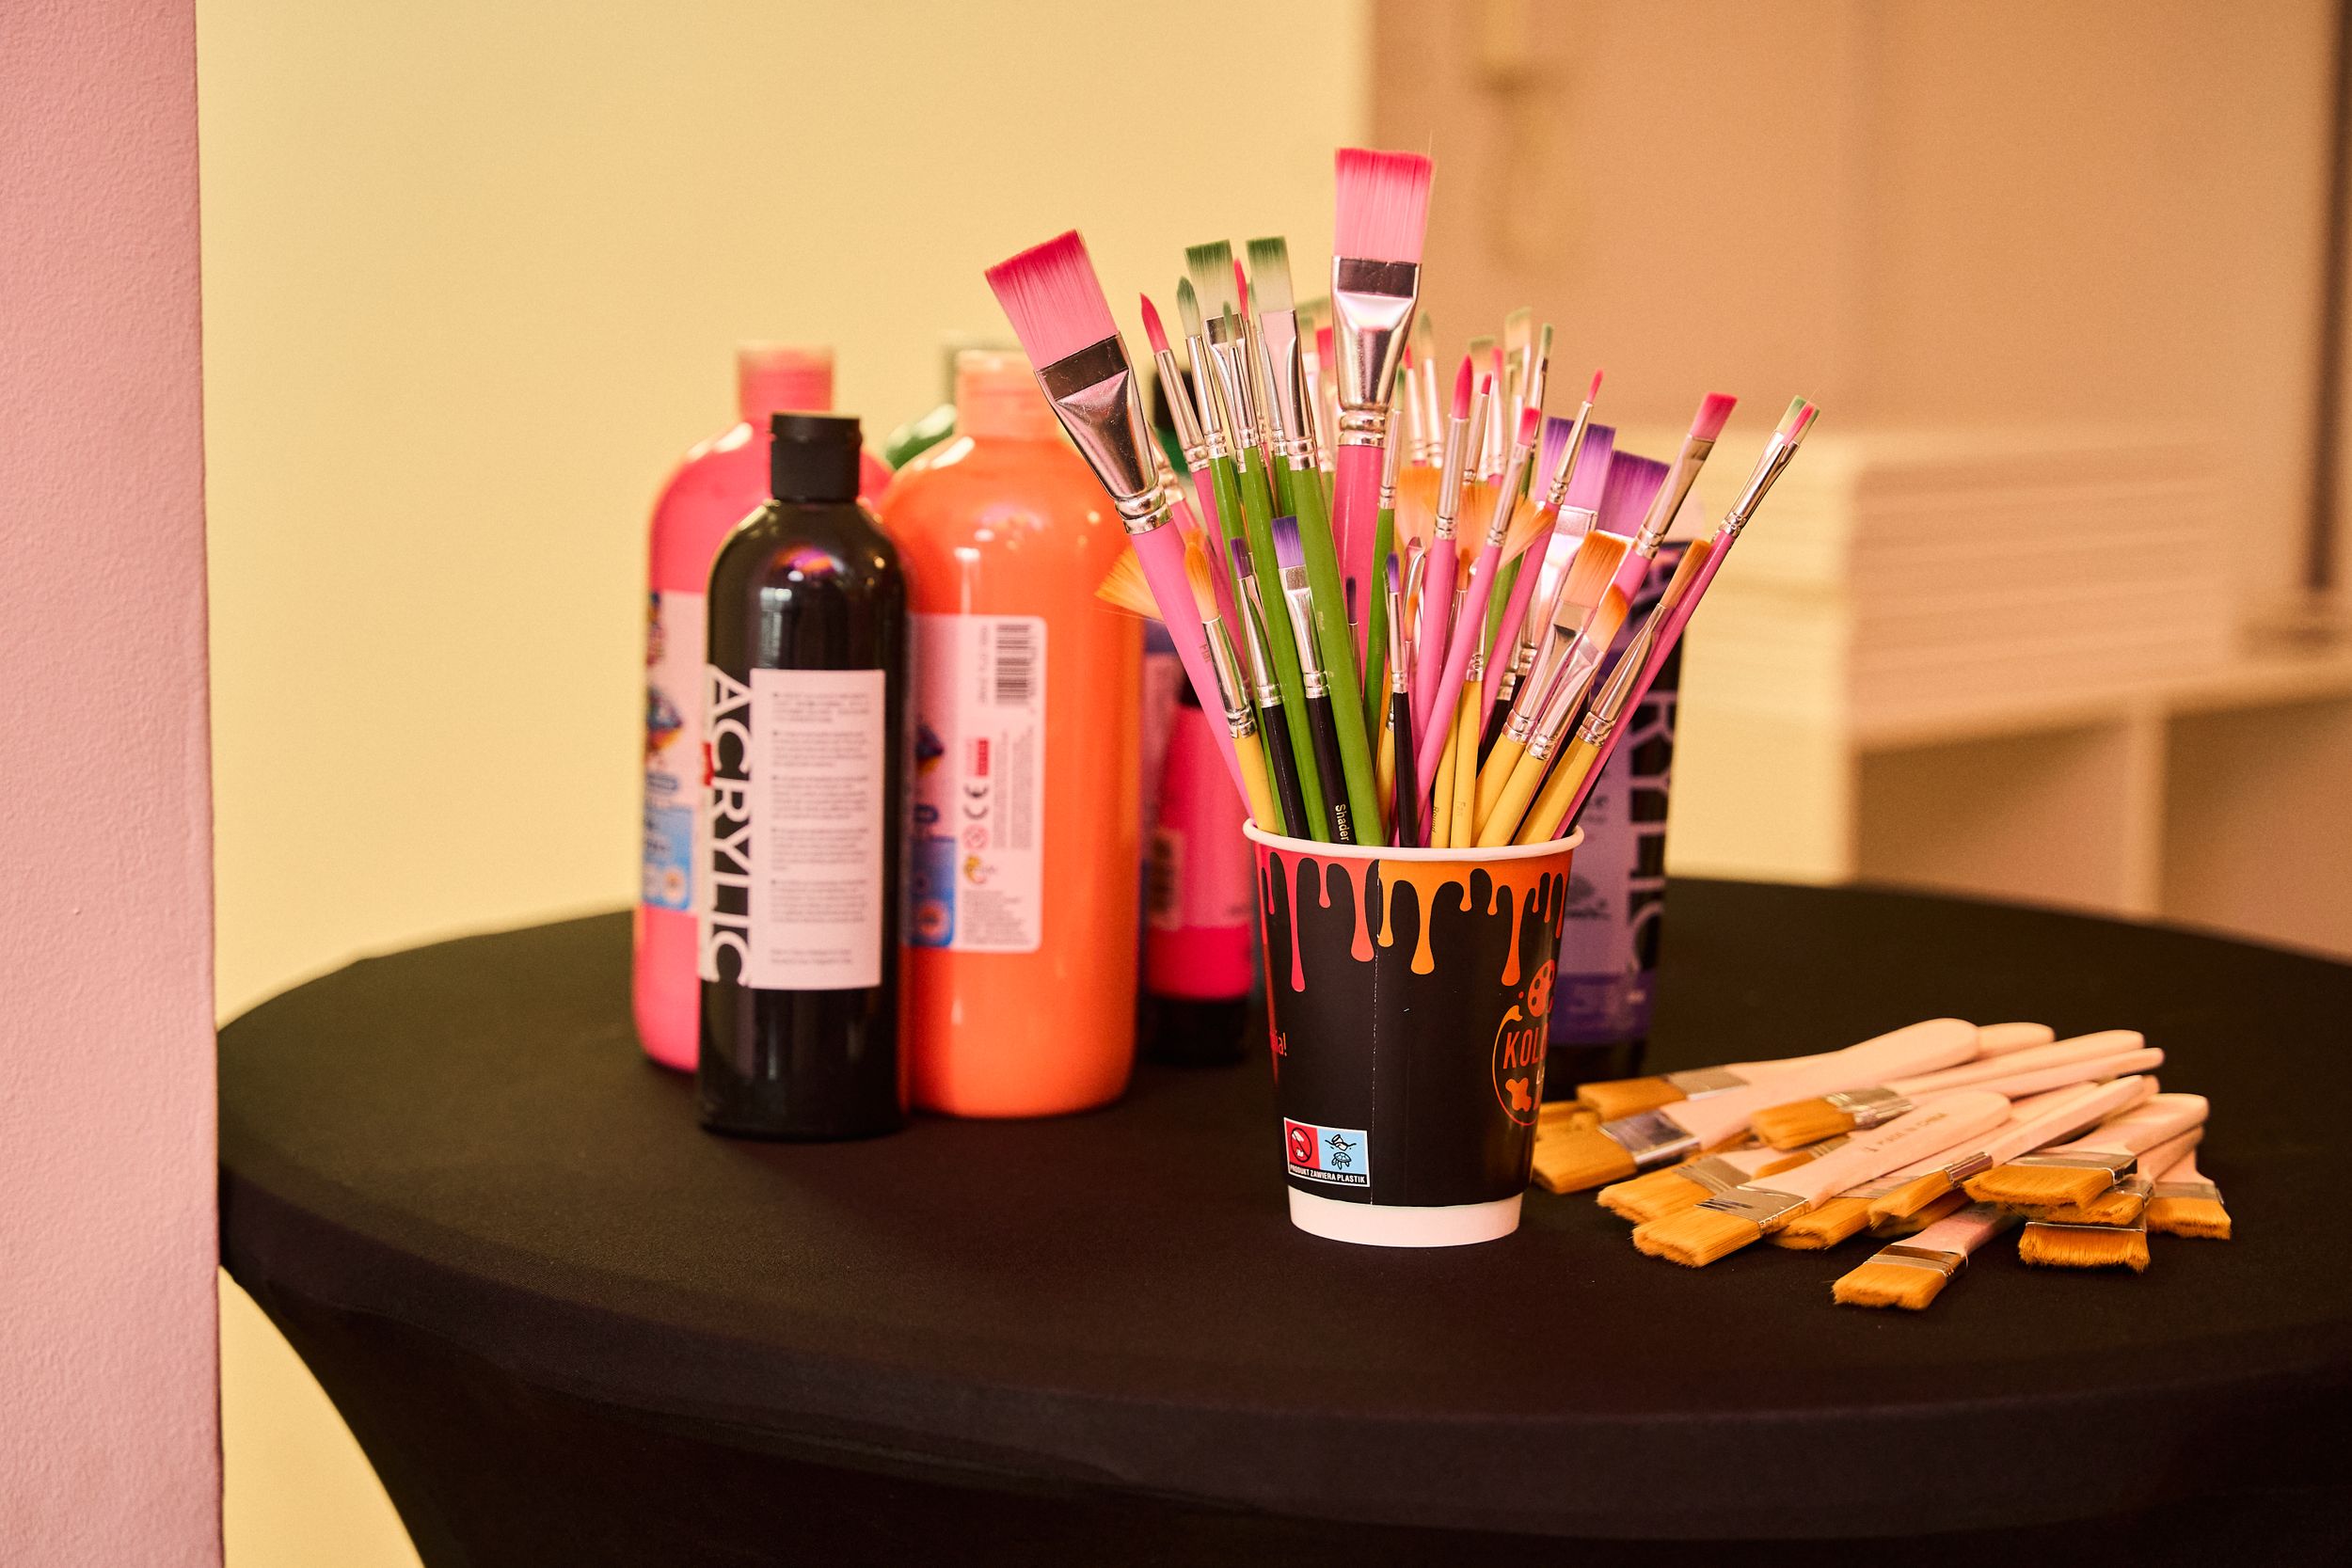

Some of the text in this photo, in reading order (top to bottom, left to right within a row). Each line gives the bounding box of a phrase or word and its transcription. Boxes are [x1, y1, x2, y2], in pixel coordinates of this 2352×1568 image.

[700, 664, 752, 988] ACRYLIC
[1335, 803, 1350, 841] Shader
[1431, 805, 1439, 833] Round
[1311, 1169, 1336, 1180] ZAWIERA
[1337, 1174, 1365, 1183] PLASTIK
